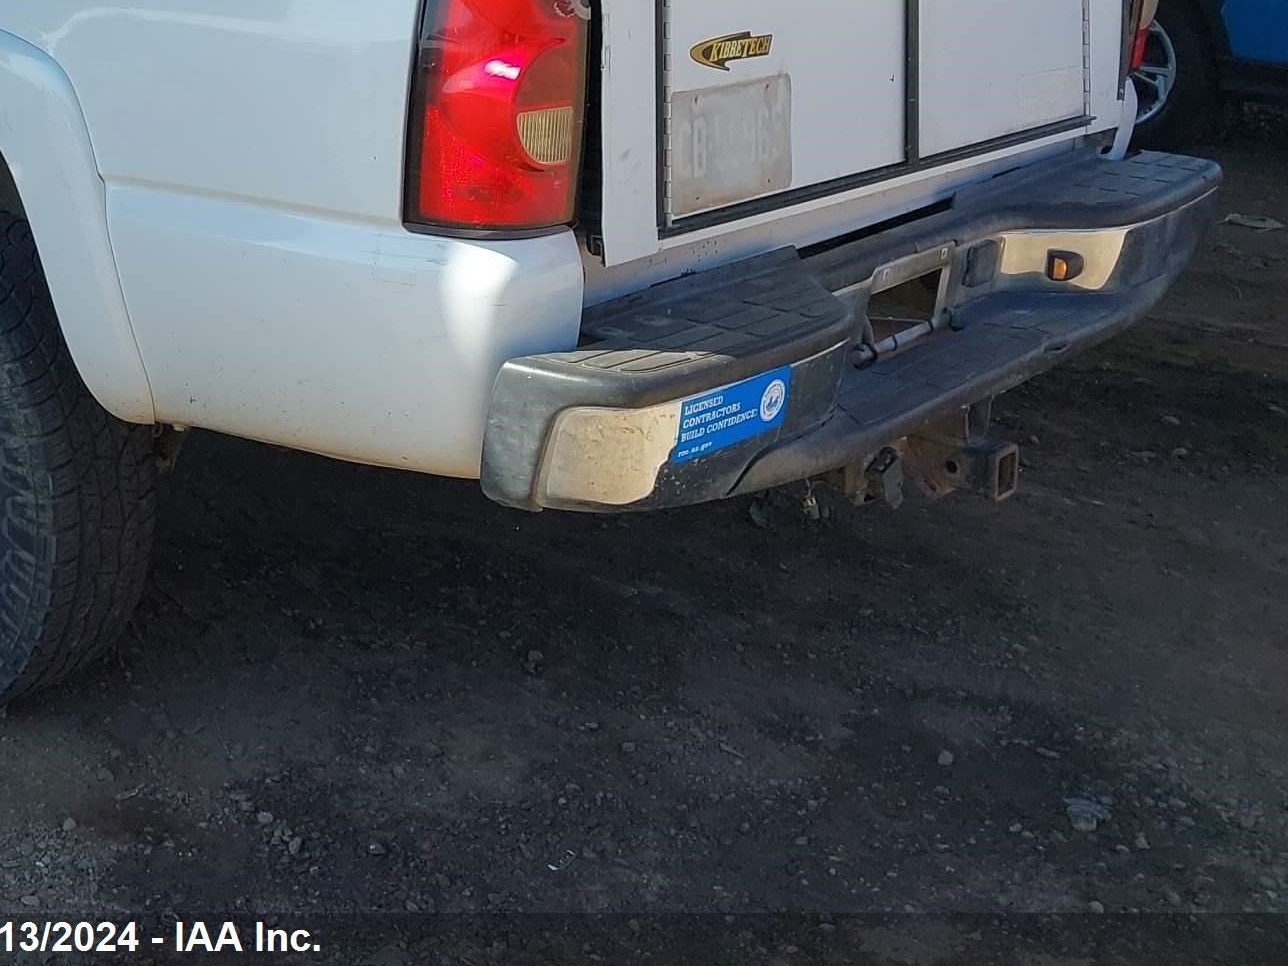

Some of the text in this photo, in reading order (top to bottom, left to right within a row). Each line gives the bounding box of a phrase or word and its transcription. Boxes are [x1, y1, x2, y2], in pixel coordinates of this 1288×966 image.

[709, 35, 771, 62] KIBBETECH
[682, 402, 742, 429] CONTRACTORS
[684, 395, 724, 415] LICENSED
[680, 427, 706, 443] BUILD
